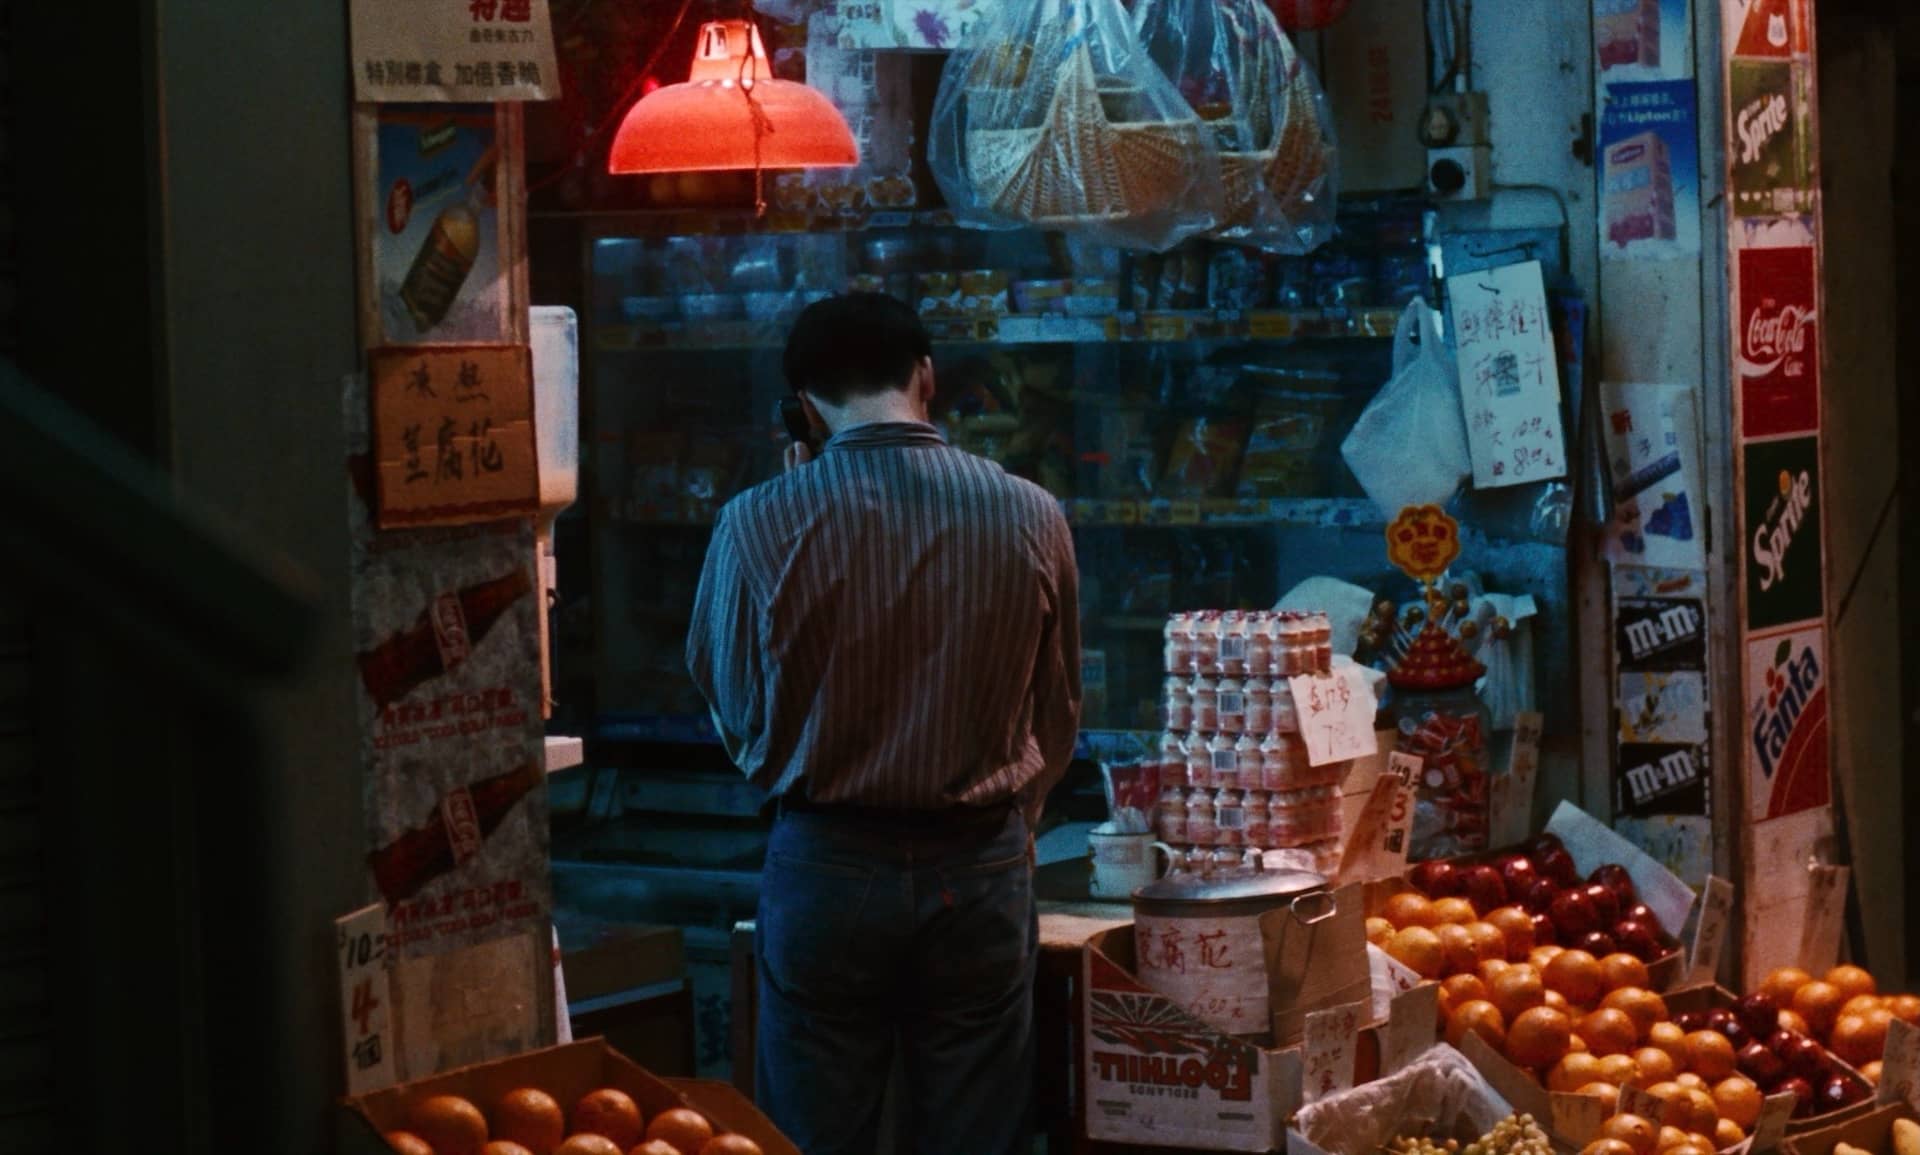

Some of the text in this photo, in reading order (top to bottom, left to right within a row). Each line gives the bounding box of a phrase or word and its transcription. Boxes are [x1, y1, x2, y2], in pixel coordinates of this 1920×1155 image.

[1737, 94, 1787, 164] Sprite
[1753, 469, 1811, 592] Sprite
[1754, 645, 1820, 779] Fanta
[1391, 793, 1407, 821] 3
[352, 976, 379, 1035] 4
[1093, 1051, 1252, 1101] FOOTHILL
[1129, 1084, 1199, 1099] REDLANDS
